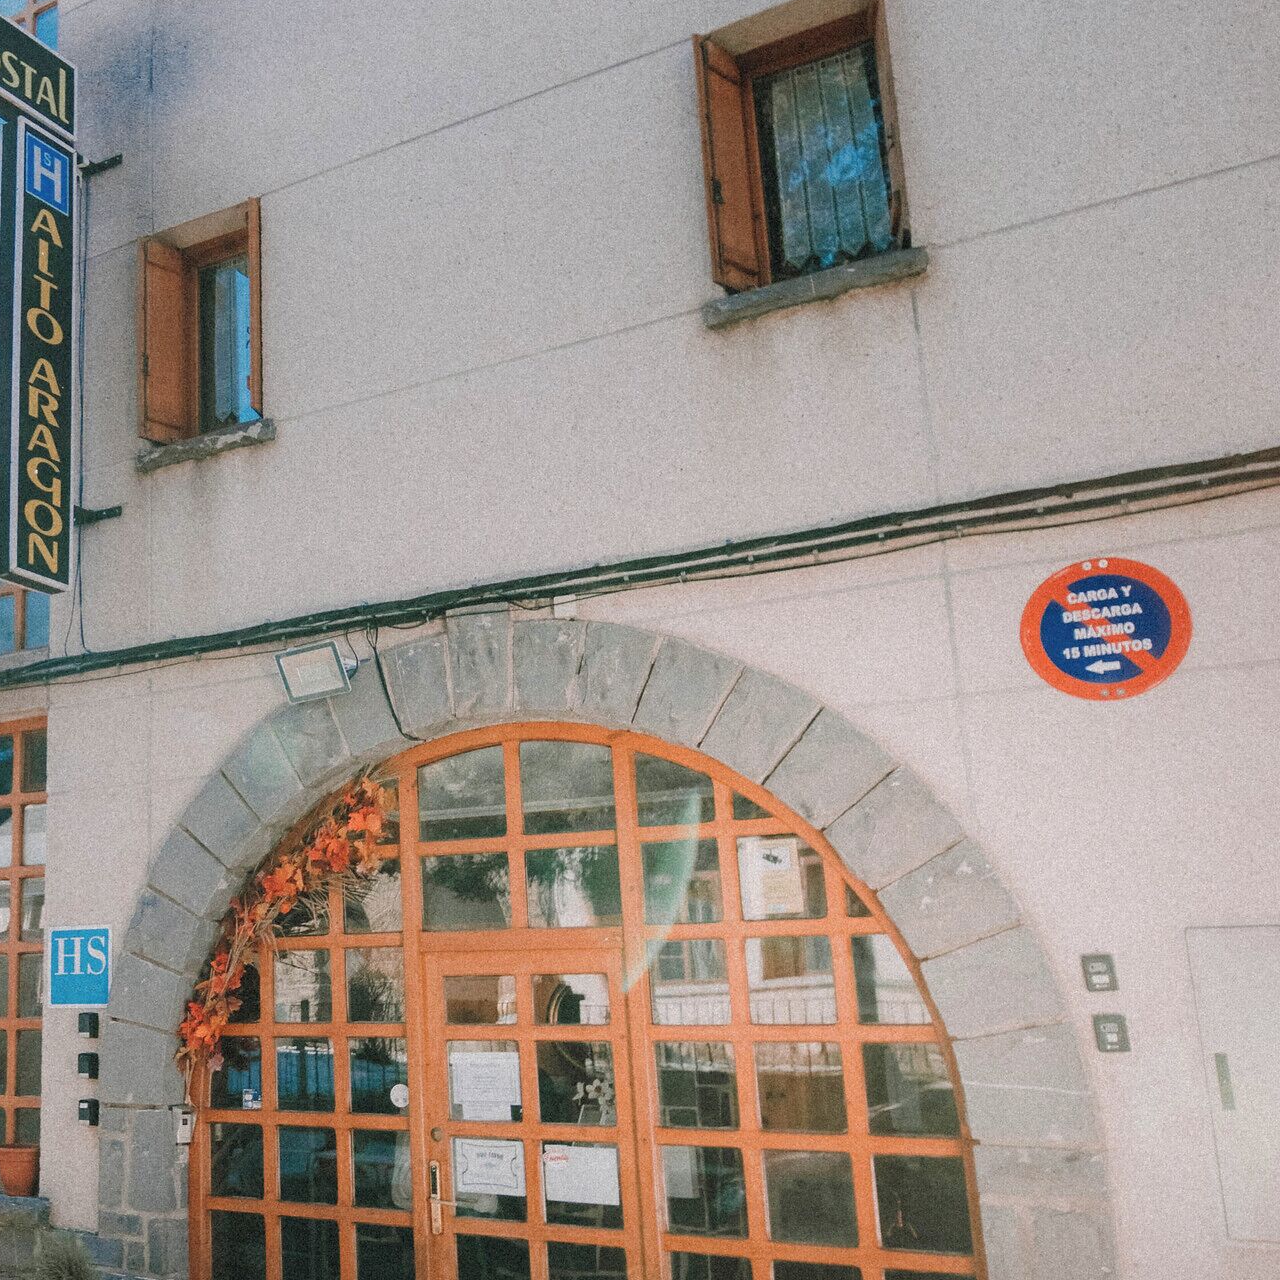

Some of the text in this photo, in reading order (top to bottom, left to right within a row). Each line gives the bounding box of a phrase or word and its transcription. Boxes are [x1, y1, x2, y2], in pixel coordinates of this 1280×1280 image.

[33, 145, 62, 204] H
[23, 208, 63, 575] ALTO ARAGON
[1067, 585, 1132, 604] CARGA Y
[1062, 602, 1143, 623] DESCARGA
[1063, 638, 1153, 660] 15 MINUTOS
[53, 935, 107, 976] HS
